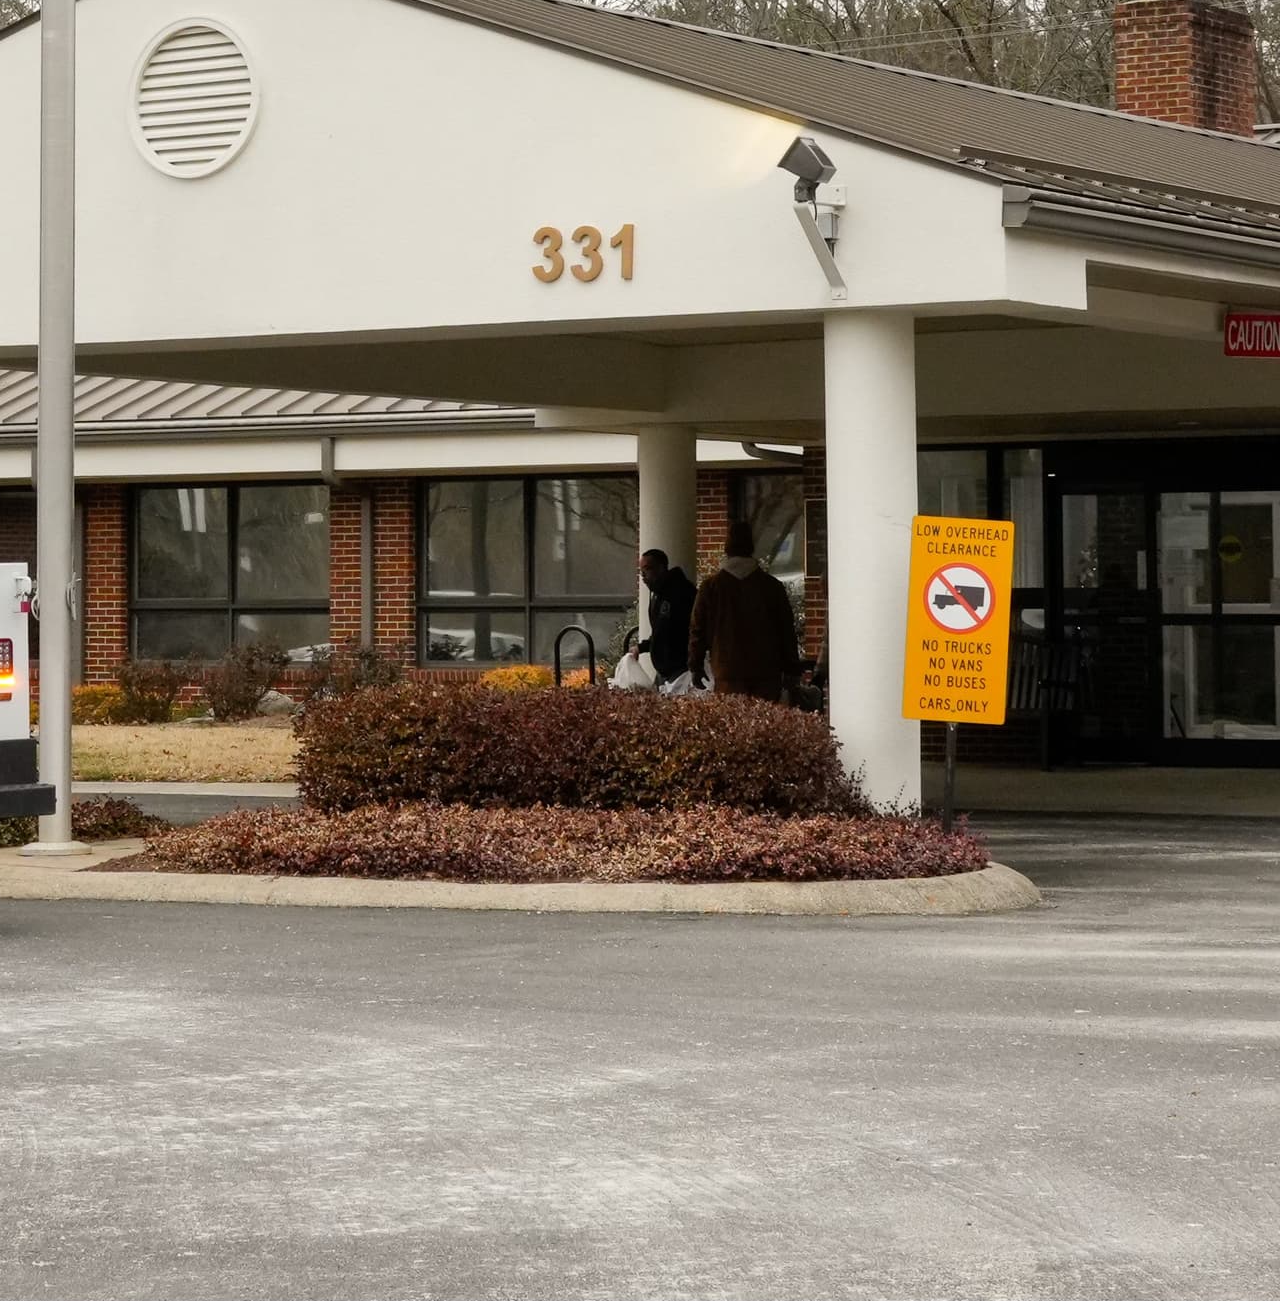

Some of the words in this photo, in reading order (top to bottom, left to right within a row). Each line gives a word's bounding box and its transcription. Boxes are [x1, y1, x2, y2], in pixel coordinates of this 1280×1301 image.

[532, 223, 635, 283] 331
[916, 523, 941, 537] LOW
[945, 525, 1009, 541] OVERHEAD
[927, 541, 997, 557] CLEARANCE
[922, 639, 939, 652] NO
[944, 640, 992, 655] TRUCKS
[929, 657, 946, 670] NO
[951, 659, 983, 672] VANS
[924, 674, 941, 687] NO
[946, 675, 986, 690] BUSES
[919, 696, 951, 710] CARS
[956, 699, 989, 713] ONLY
